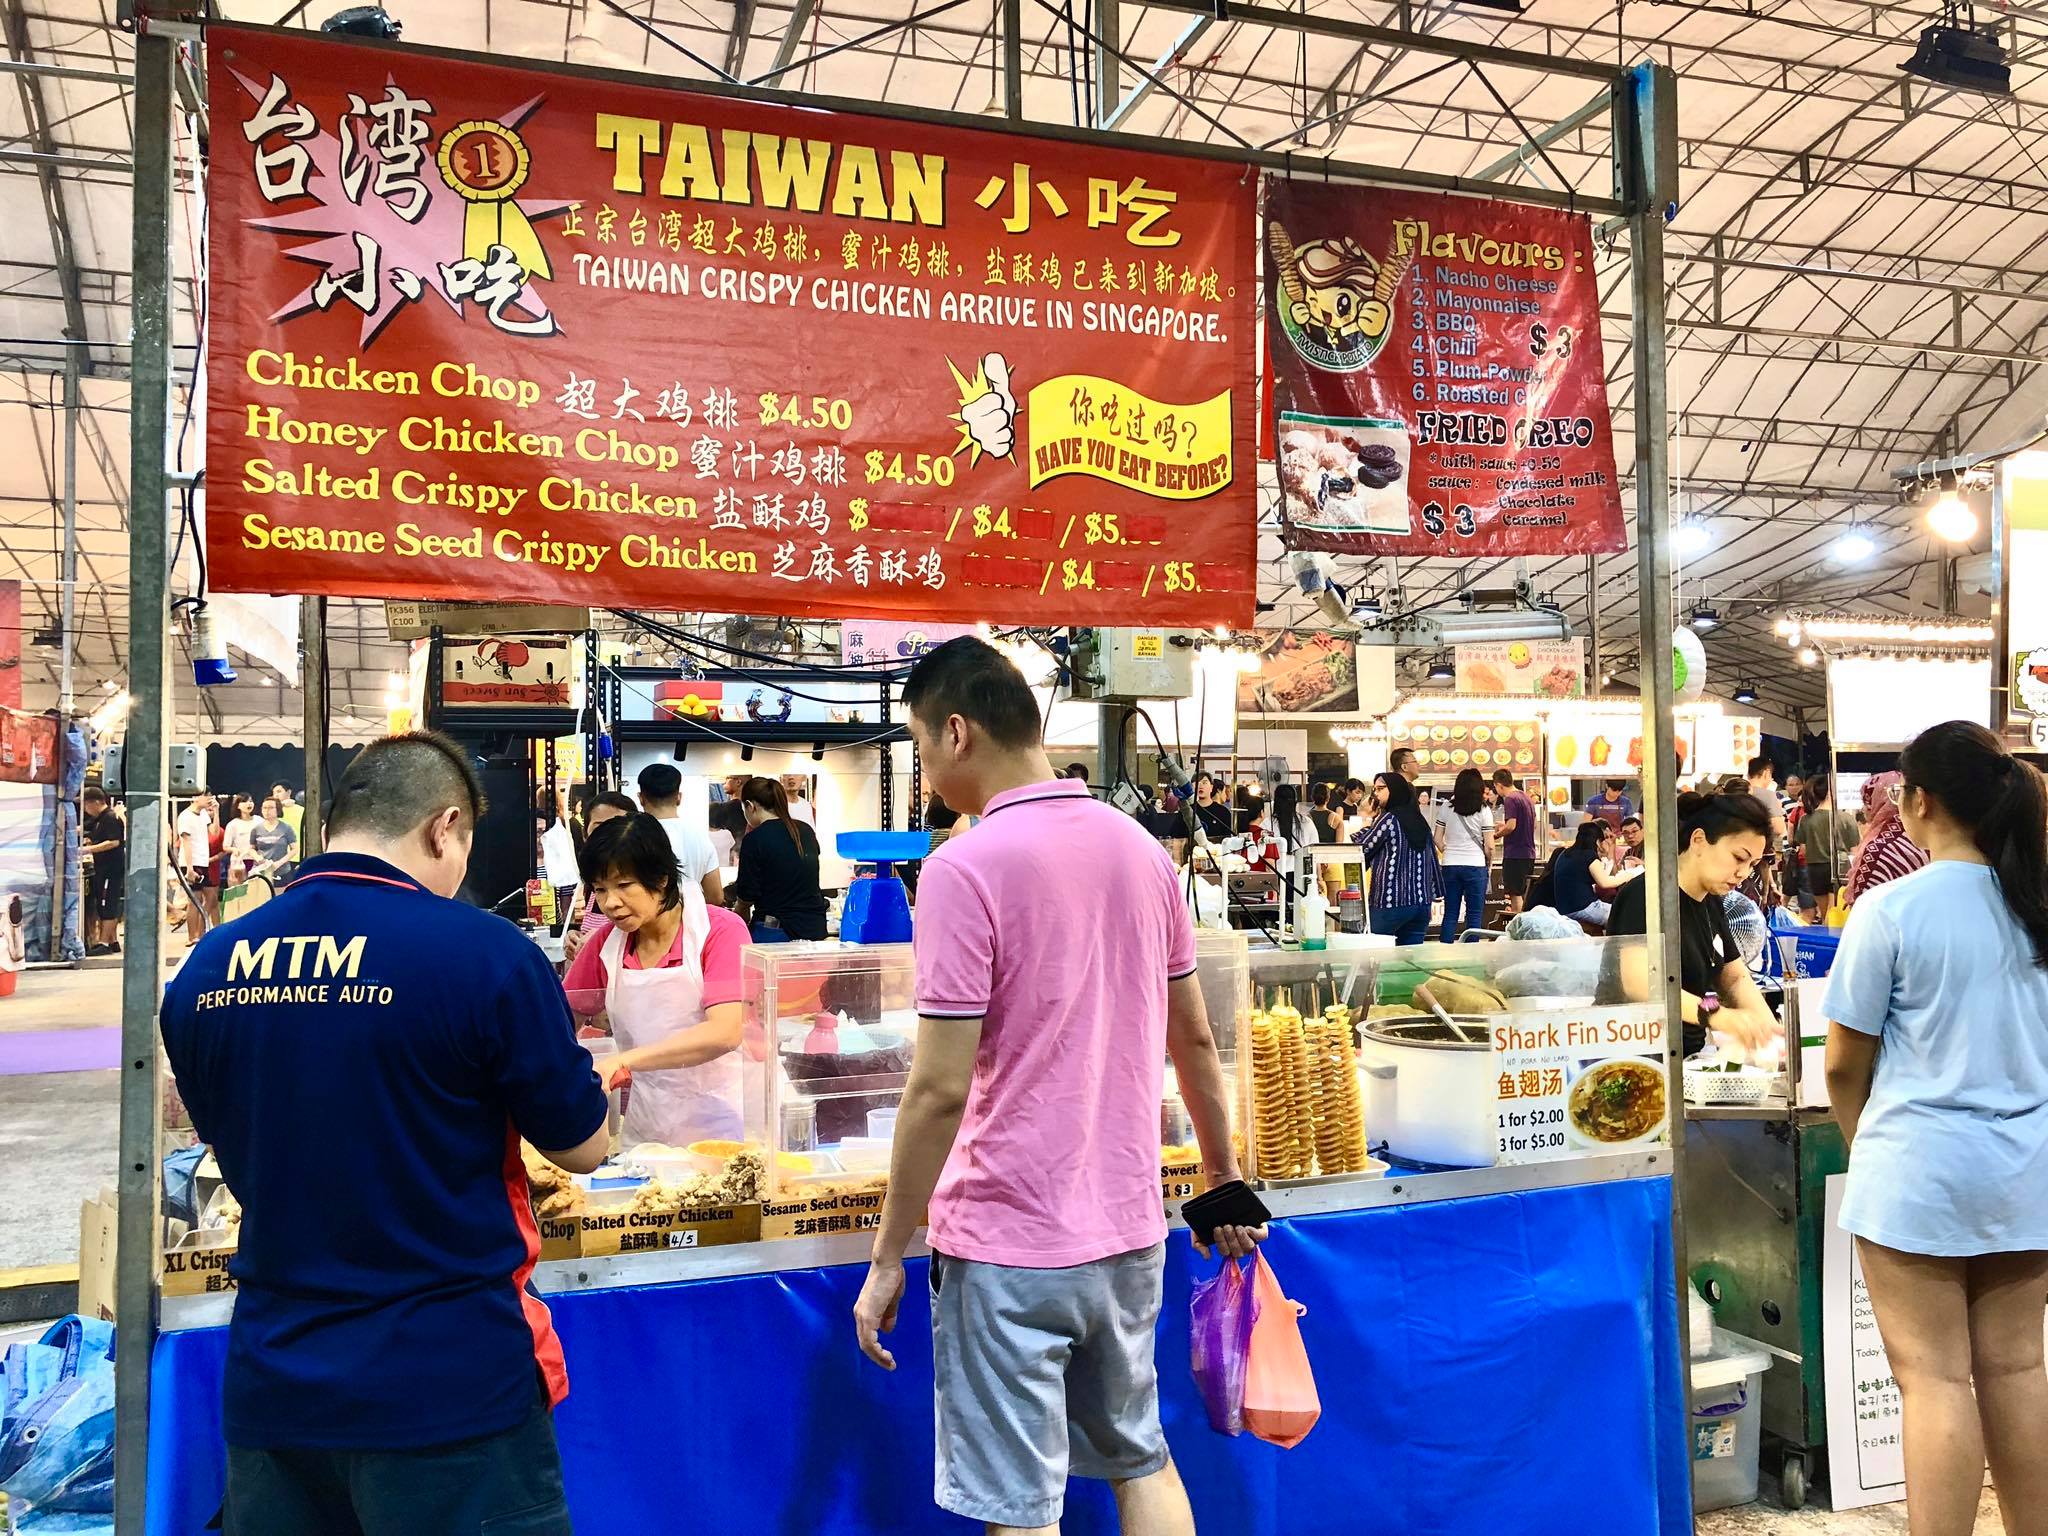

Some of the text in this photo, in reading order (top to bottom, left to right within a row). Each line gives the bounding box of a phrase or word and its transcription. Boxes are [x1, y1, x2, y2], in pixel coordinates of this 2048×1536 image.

[243, 72, 436, 222] 台湾
[596, 112, 1183, 247] TAIWAN 小吃
[313, 233, 557, 336] 小吃
[1412, 265, 1558, 294] 1. Nacho Cheese
[572, 253, 1228, 343] TAIWAN CRISPY CHICKEN ARRIVE IN SINGAPORE.
[1412, 289, 1541, 315] 2. Mayonnaise
[1412, 313, 1476, 334] 3. BBQ
[1412, 335, 1476, 357] 4. Chili
[1412, 359, 1430, 378] 5.
[1436, 359, 1482, 380] Plum
[246, 349, 854, 432] Chicken Chop 超大鸡排 $4.50
[1412, 383, 1430, 401] 6.
[1436, 383, 1509, 406] Roasted
[1416, 411, 1507, 447] FRIED
[245, 405, 956, 488] Honey Chicken Chop 蜜汁鸡排 $4.50
[1035, 437, 1228, 491] HAVE YOU EAT BEFORE?
[1441, 453, 1476, 470] with
[1479, 457, 1517, 471] sauce
[1569, 472, 1607, 488] milk
[242, 459, 380, 500] Salted
[391, 470, 528, 515] Crispy
[539, 477, 699, 520] Chicken
[709, 487, 832, 537] 盐酥鸡
[1499, 494, 1576, 509] Chocolate
[1502, 511, 1568, 527] Caramel
[242, 514, 385, 553] Sesame
[394, 523, 483, 560] Seed
[493, 528, 611, 573] Crispy
[620, 533, 758, 574] Chicken
[771, 540, 947, 590] 芝麻香酥鸡
[389, 606, 414, 615] TK356
[393, 618, 414, 626] C100
[227, 936, 368, 982] MTM
[197, 985, 394, 1012] PERFORMANCE AUTO
[1495, 1020, 1662, 1051] Shark Fin Soup
[1497, 1068, 1563, 1100] 鱼翅汤
[1499, 1109, 1564, 1128] 1 for $2.00
[1500, 1132, 1565, 1151] 3 for $5.00
[1161, 1163, 1198, 1178] Sweet
[762, 1203, 807, 1217] Sesame
[810, 1197, 838, 1212] Seed
[841, 1194, 880, 1208] Crispy
[581, 1207, 734, 1231] Salted Crispy Chicken
[794, 1214, 851, 1236] 芝麻香酥鸡
[540, 1221, 576, 1241] Chop
[620, 1232, 658, 1251] 盐酥鸡
[164, 1250, 233, 1273] XL Crisp
[1854, 1279, 1868, 1290] Ku
[1854, 1308, 1873, 1318] Choc
[1854, 1321, 1875, 1331] Plain
